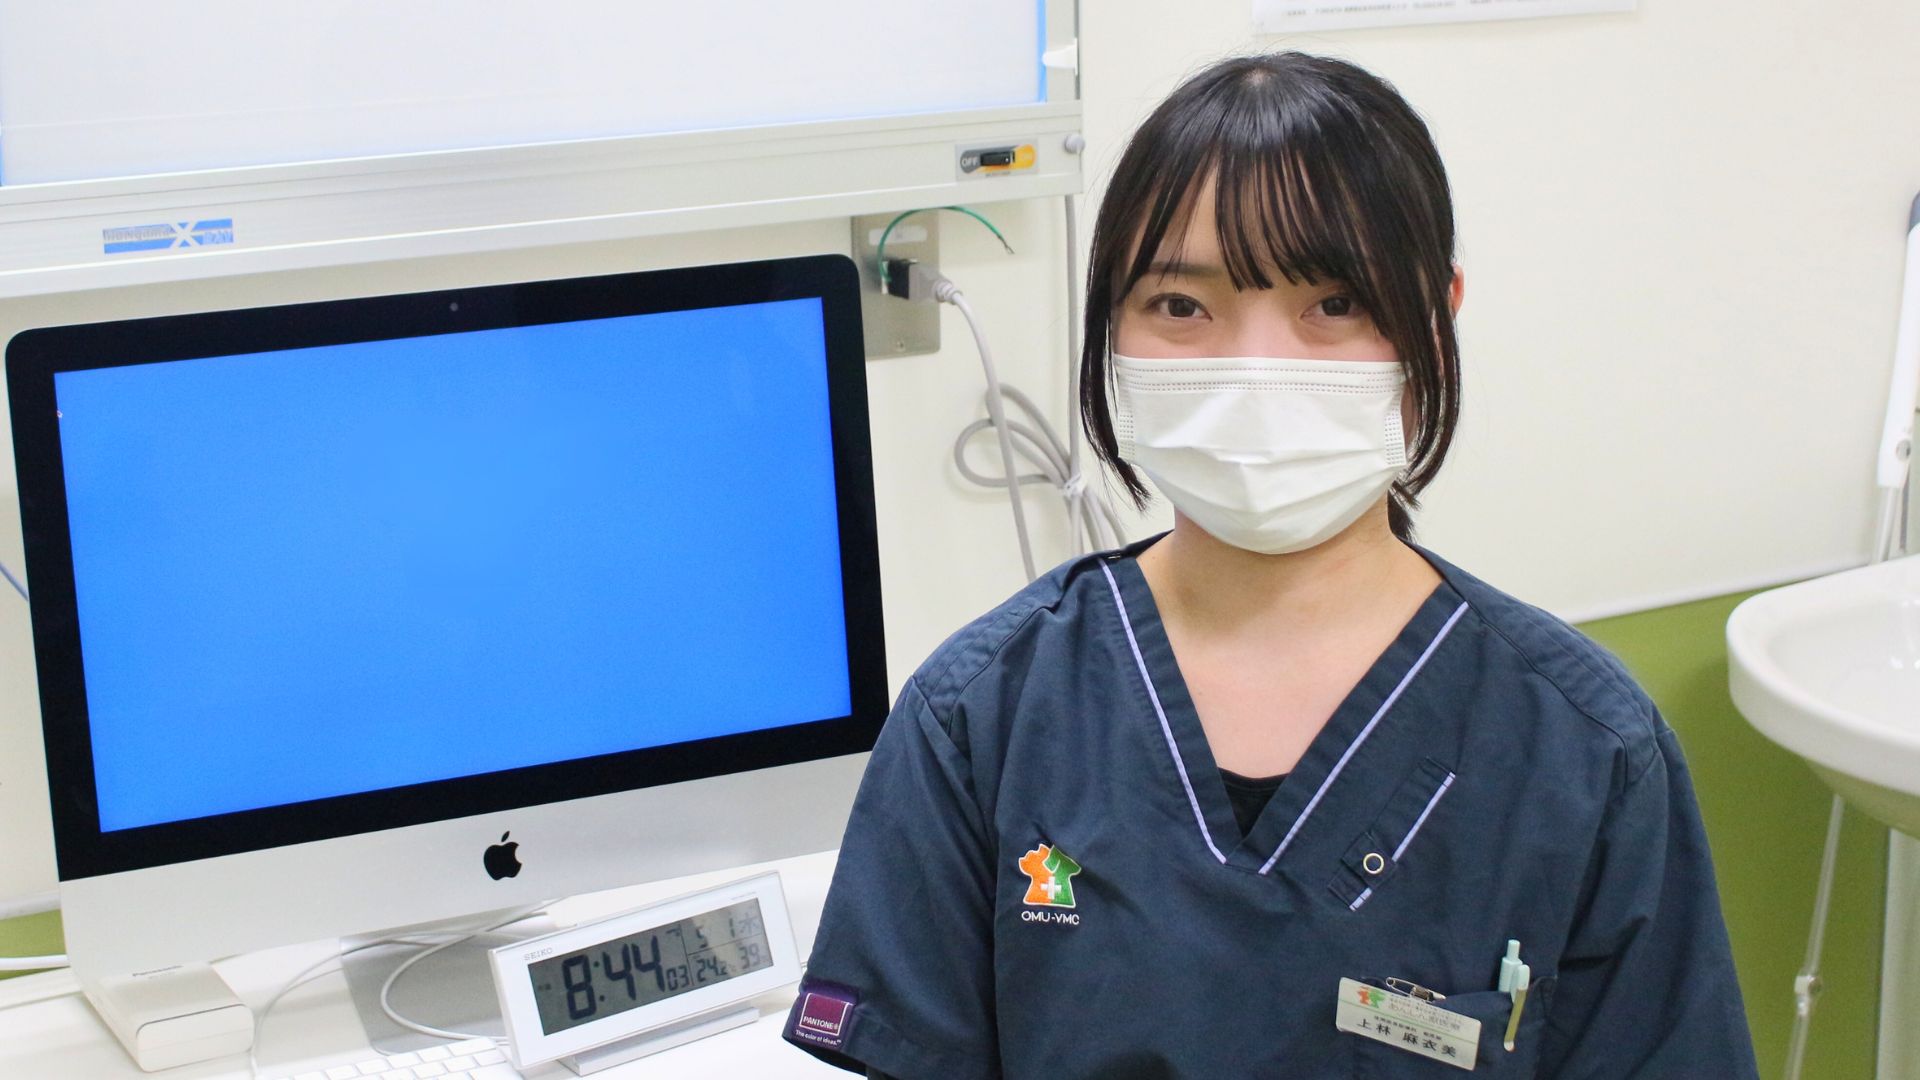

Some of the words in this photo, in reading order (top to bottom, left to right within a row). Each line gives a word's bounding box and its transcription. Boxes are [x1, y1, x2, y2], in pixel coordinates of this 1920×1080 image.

[962, 156, 979, 167] OFF
[1021, 910, 1080, 926] OMU-VMC
[524, 947, 553, 961] SEIKO
[738, 943, 761, 970] 39
[561, 935, 666, 1021] 8:44
[666, 965, 690, 991] 03
